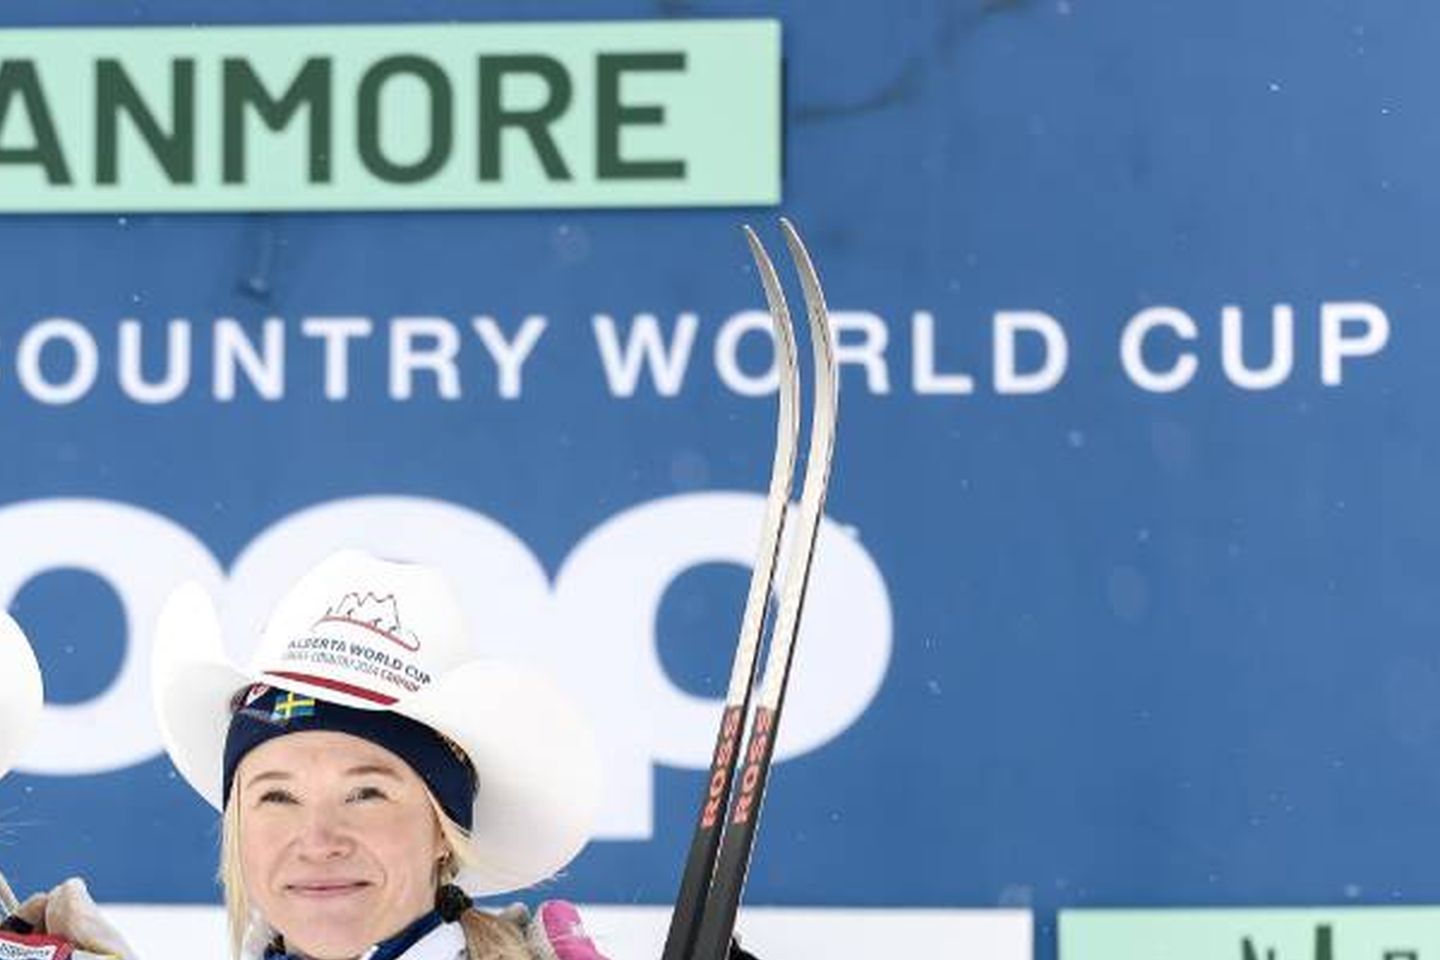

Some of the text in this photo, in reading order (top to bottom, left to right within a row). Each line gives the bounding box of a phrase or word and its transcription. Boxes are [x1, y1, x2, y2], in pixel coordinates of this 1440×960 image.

[592, 311, 1069, 397] WORLD
[1119, 302, 1390, 393] CUP
[287, 637, 347, 654] ALBERTA
[350, 642, 403, 671] WORLD
[405, 664, 432, 685] CUP
